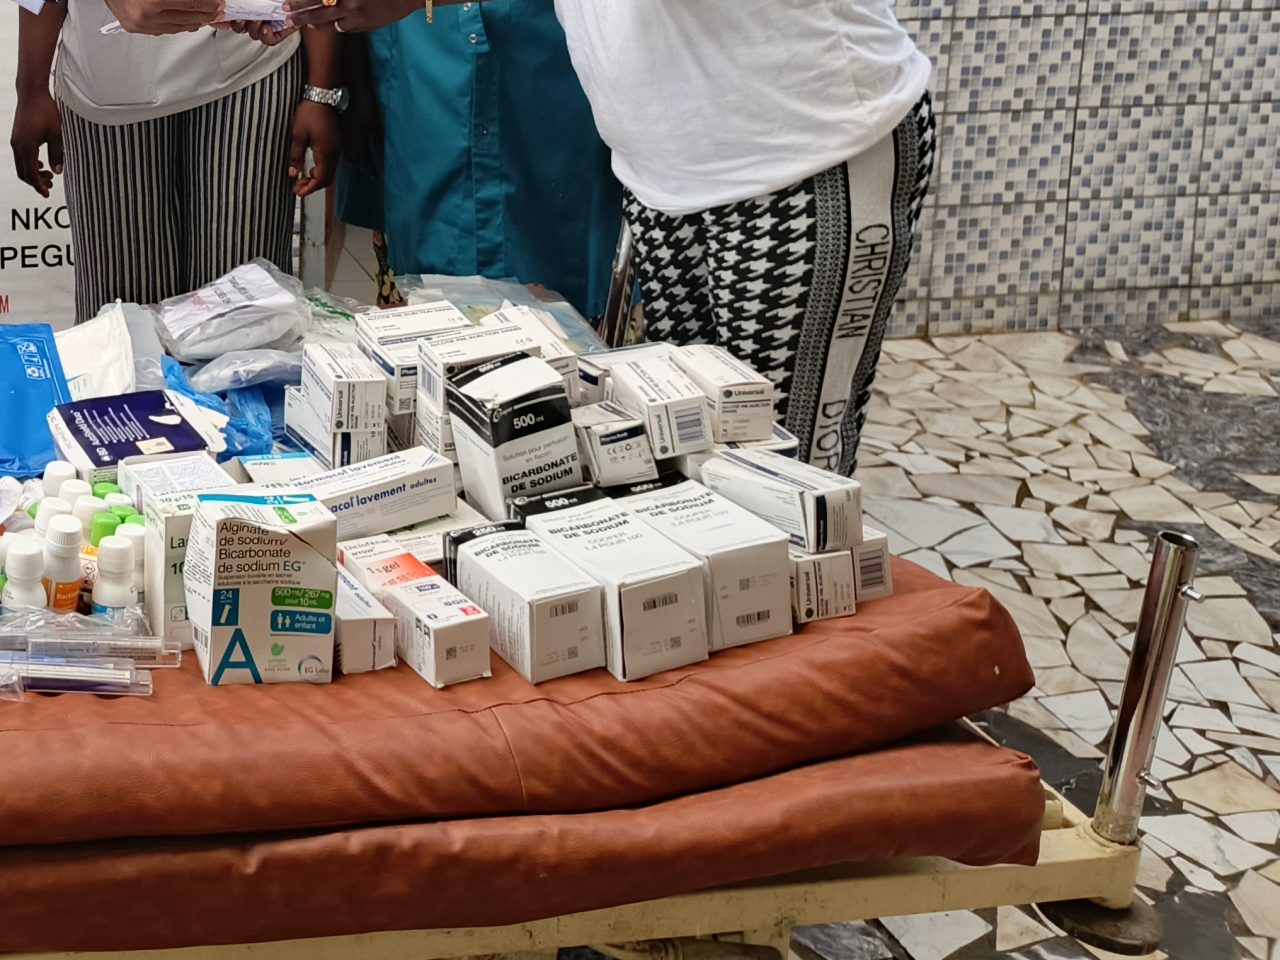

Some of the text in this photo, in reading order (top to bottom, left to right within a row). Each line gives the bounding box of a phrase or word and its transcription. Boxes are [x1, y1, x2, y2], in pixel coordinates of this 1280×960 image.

[835, 223, 890, 339] CHRISTIAN
[734, 389, 765, 397] Universal
[513, 413, 536, 429] 500
[813, 398, 847, 474] DIOR
[502, 452, 578, 486] BICARBONATE
[510, 467, 573, 493] DE SODIUM
[356, 483, 406, 507] lavement
[409, 477, 437, 490] adultes
[545, 497, 569, 508] 500
[634, 490, 715, 514] BICARBONATE
[649, 498, 715, 517] DE SODIUM
[220, 522, 269, 536] Alginate
[548, 511, 630, 535] BICARBONATE
[563, 519, 630, 540] DE SODIUM
[219, 535, 234, 546] de
[474, 538, 541, 557] BICARBONATE
[219, 548, 291, 560] Bicarbonate
[485, 549, 499, 558] DE
[217, 562, 233, 573] de
[236, 561, 280, 572] sodium
[382, 561, 401, 573] gel
[220, 590, 232, 599] 24
[274, 587, 291, 596] 500
[305, 589, 320, 598] 267
[803, 571, 812, 606] Universal
